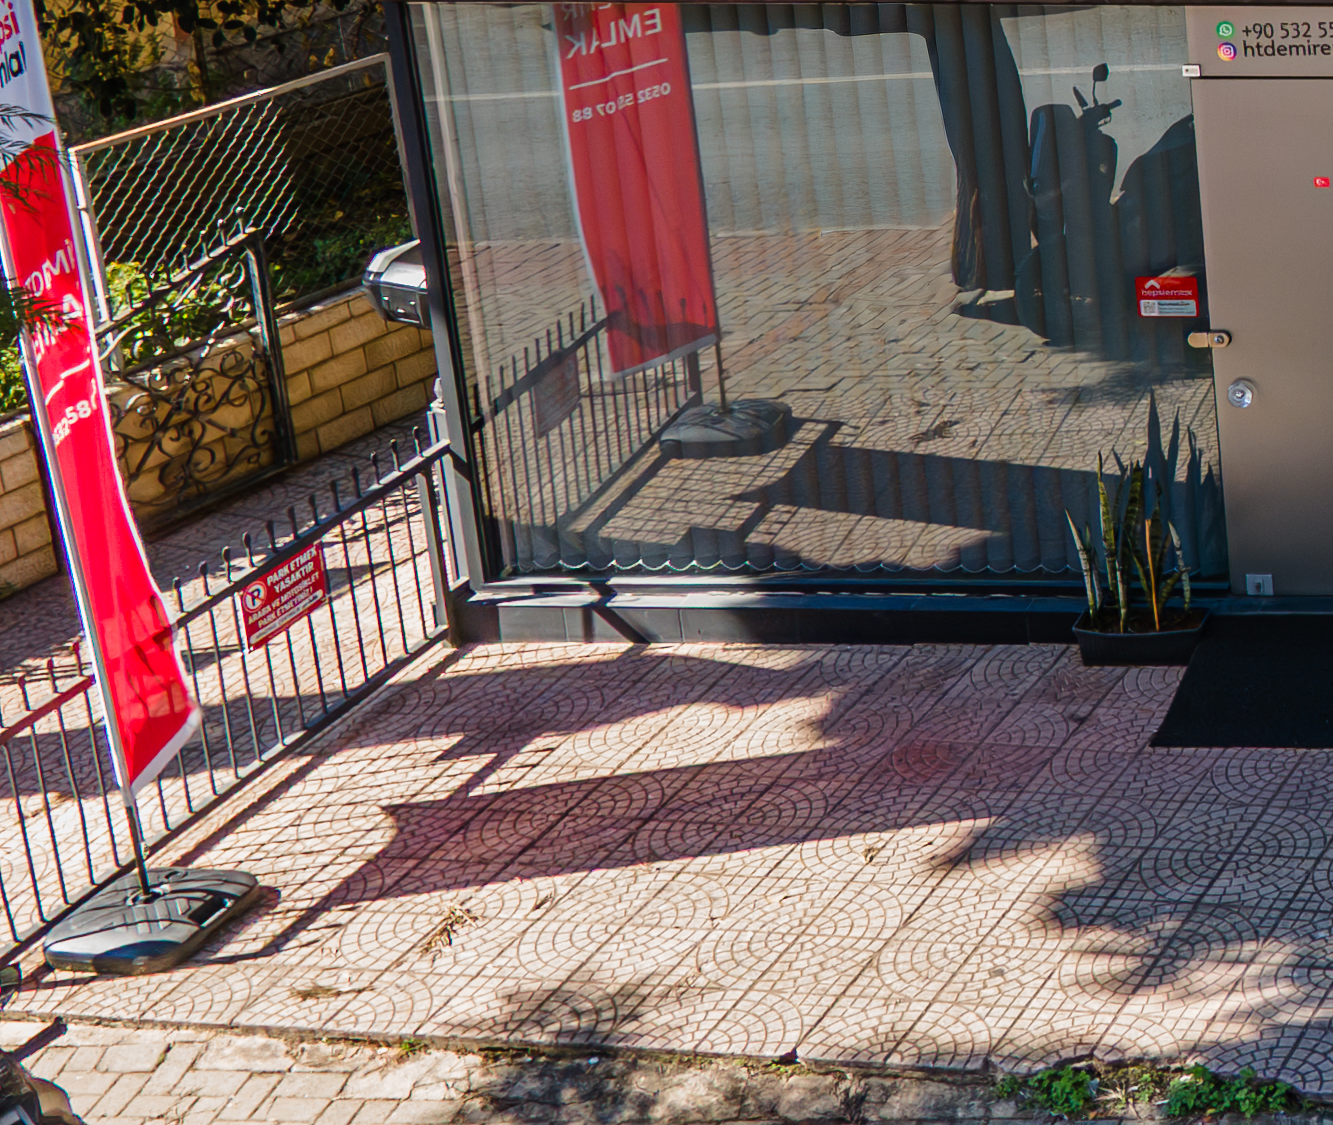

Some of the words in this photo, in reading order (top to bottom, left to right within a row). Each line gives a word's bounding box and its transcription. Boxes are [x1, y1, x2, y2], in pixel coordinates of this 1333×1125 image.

[1242, 22, 1274, 39] +90
[1280, 22, 1312, 39] 532
[267, 565, 289, 586] PARK
[290, 546, 317, 571] ETMEK
[274, 561, 314, 593] YASAKTIR
